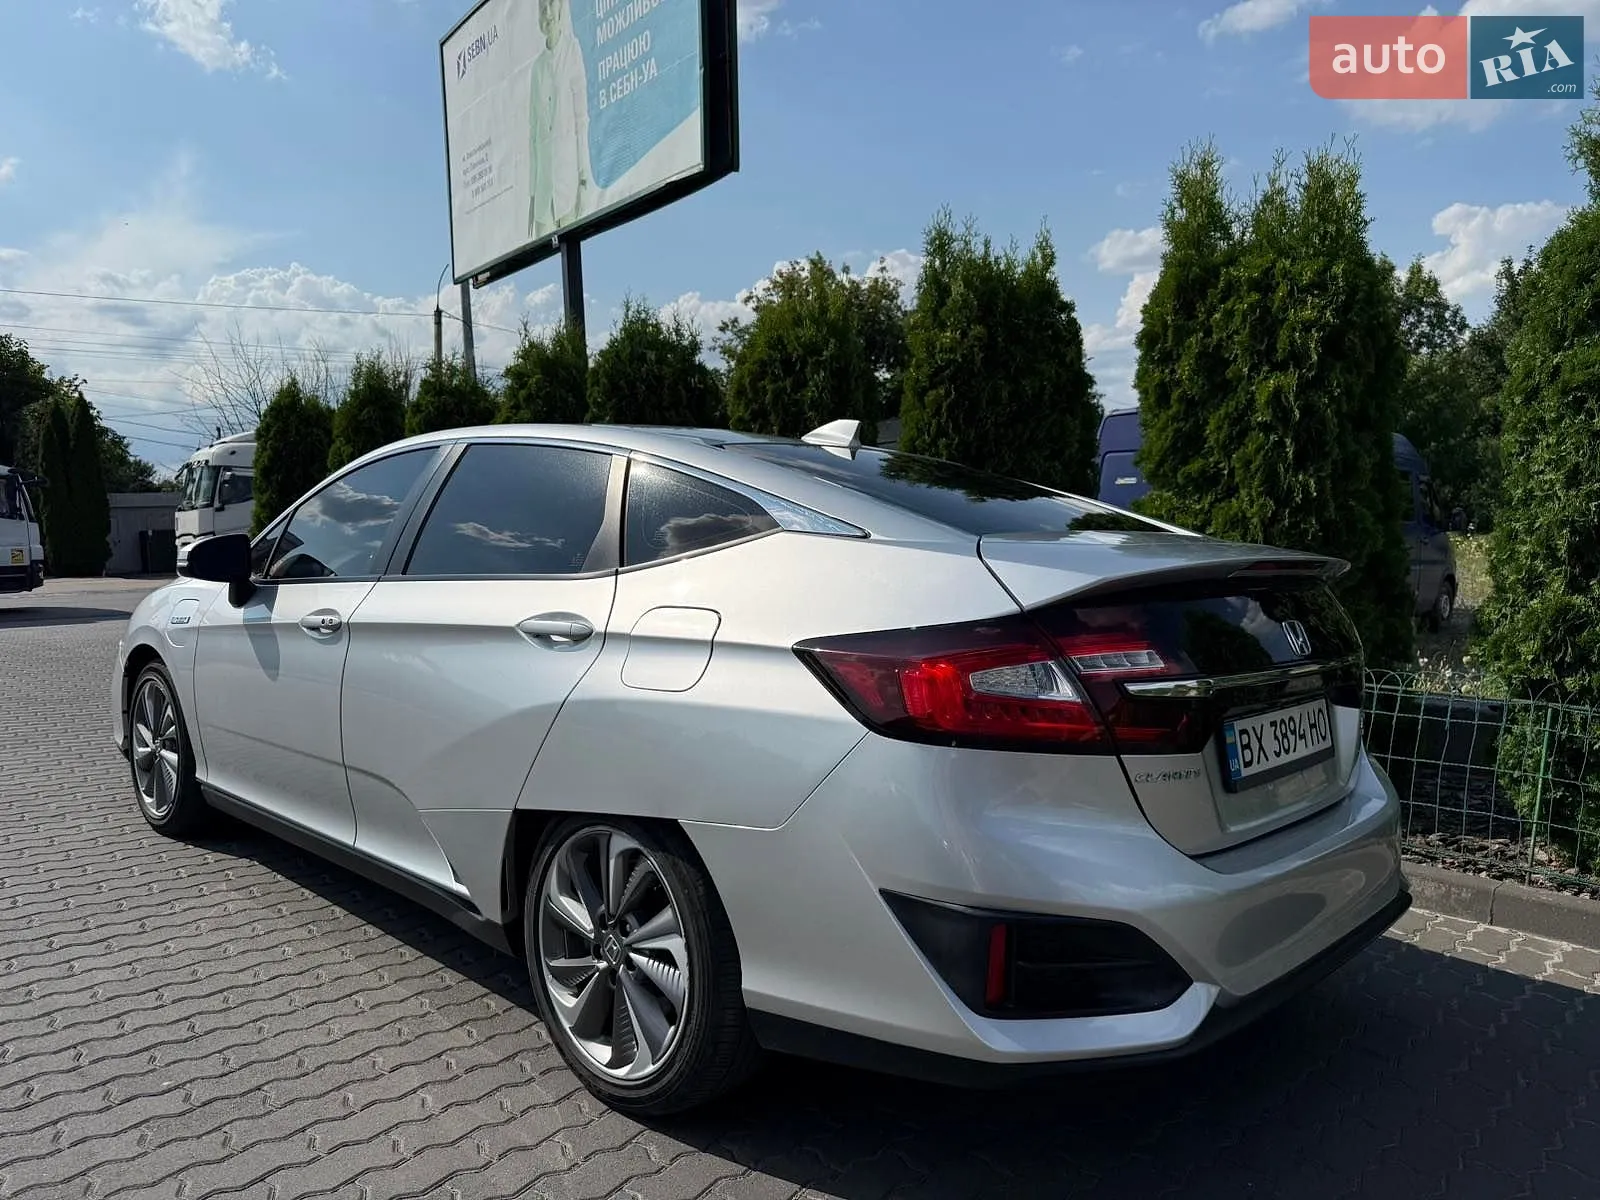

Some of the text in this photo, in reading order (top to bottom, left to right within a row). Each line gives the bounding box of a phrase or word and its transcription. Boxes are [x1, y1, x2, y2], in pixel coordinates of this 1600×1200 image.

[597, 0, 664, 48] МОЖЛИВ
[598, 29, 651, 82] ПРАЦЮЮ
[599, 56, 658, 110] В СЕБН-УА
[1238, 707, 1328, 769] BX 3894 HO
[1229, 758, 1241, 772] UA
